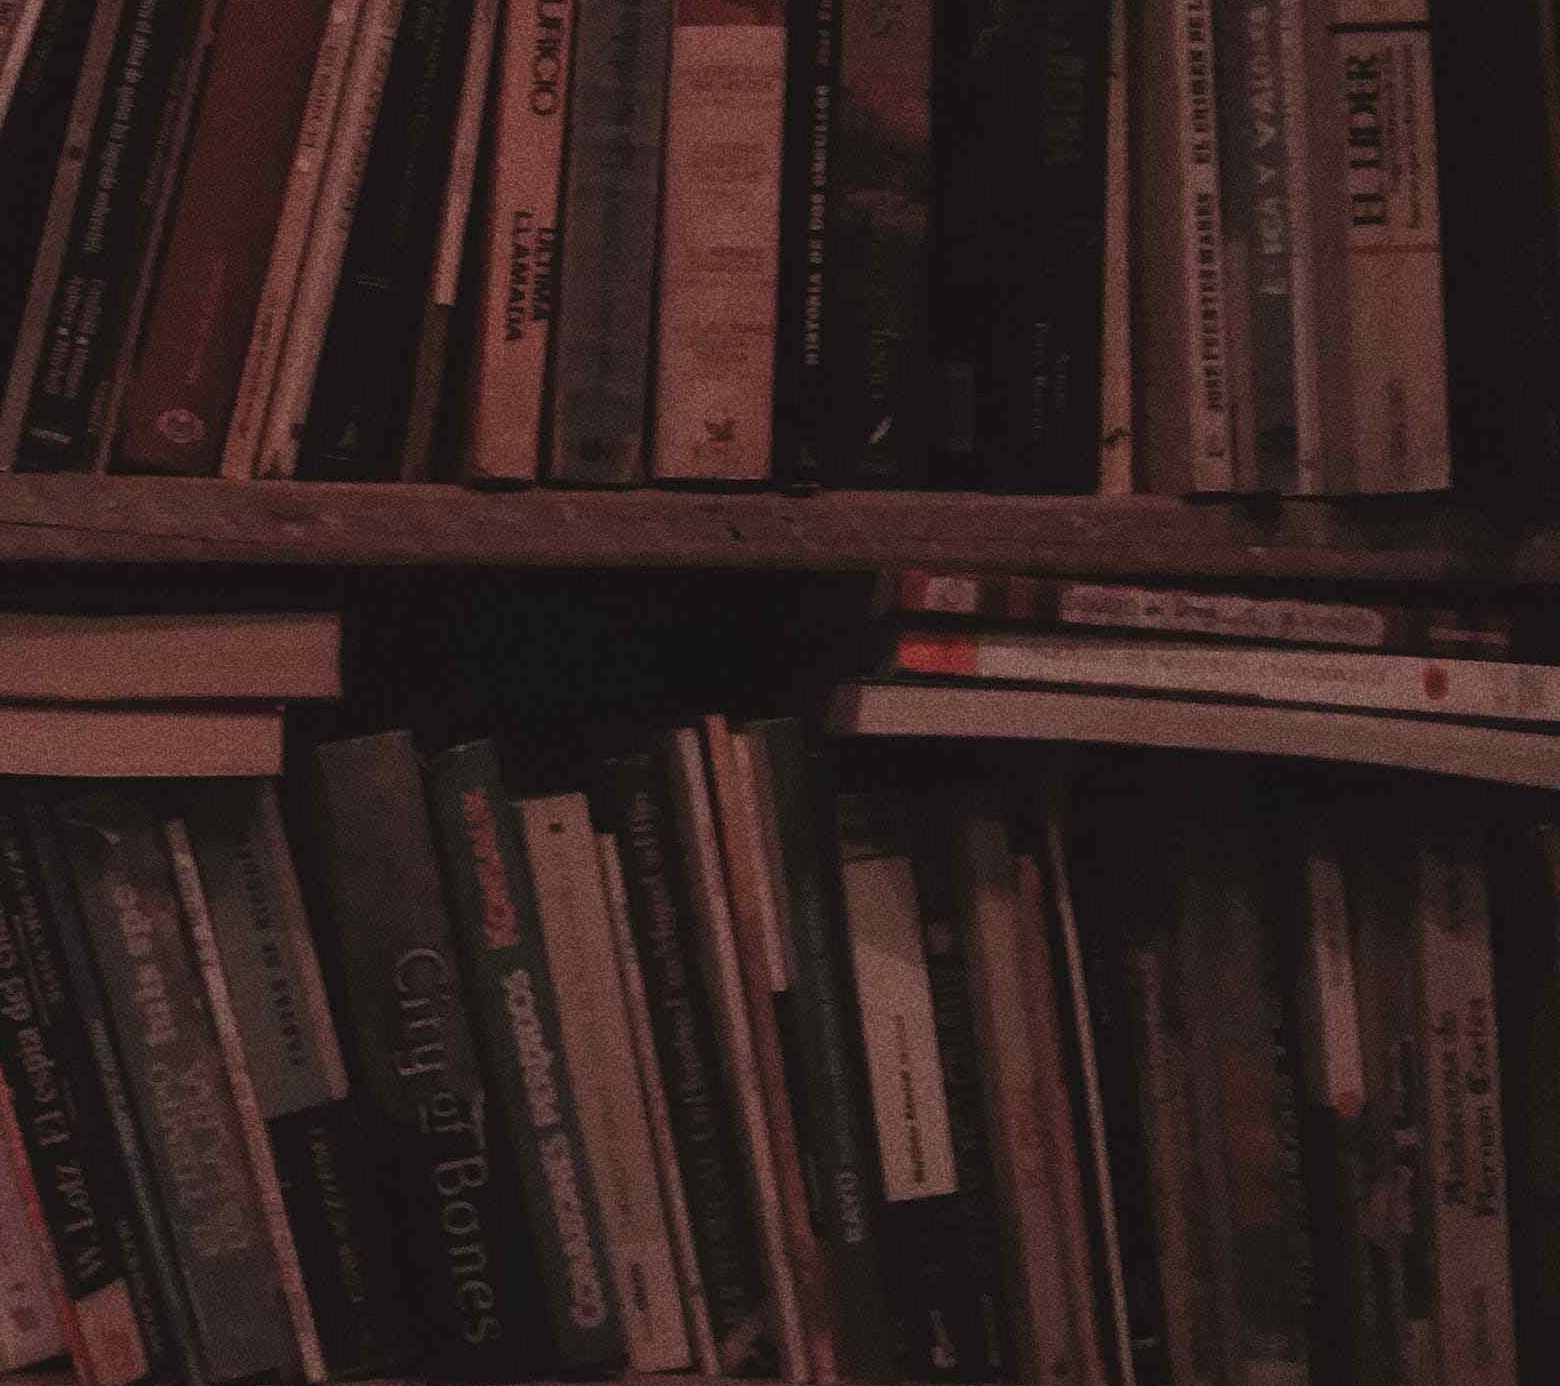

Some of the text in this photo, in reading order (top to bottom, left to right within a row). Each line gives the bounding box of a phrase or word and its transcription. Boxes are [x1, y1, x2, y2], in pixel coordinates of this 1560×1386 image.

[1192, 139, 1211, 165] EL
[1352, 185, 1389, 228] EL
[805, 272, 823, 365] HISTORIA
[1198, 268, 1221, 362] FUENTES
[37, 1111, 72, 1146] El
[392, 947, 504, 1347] City of Bones
